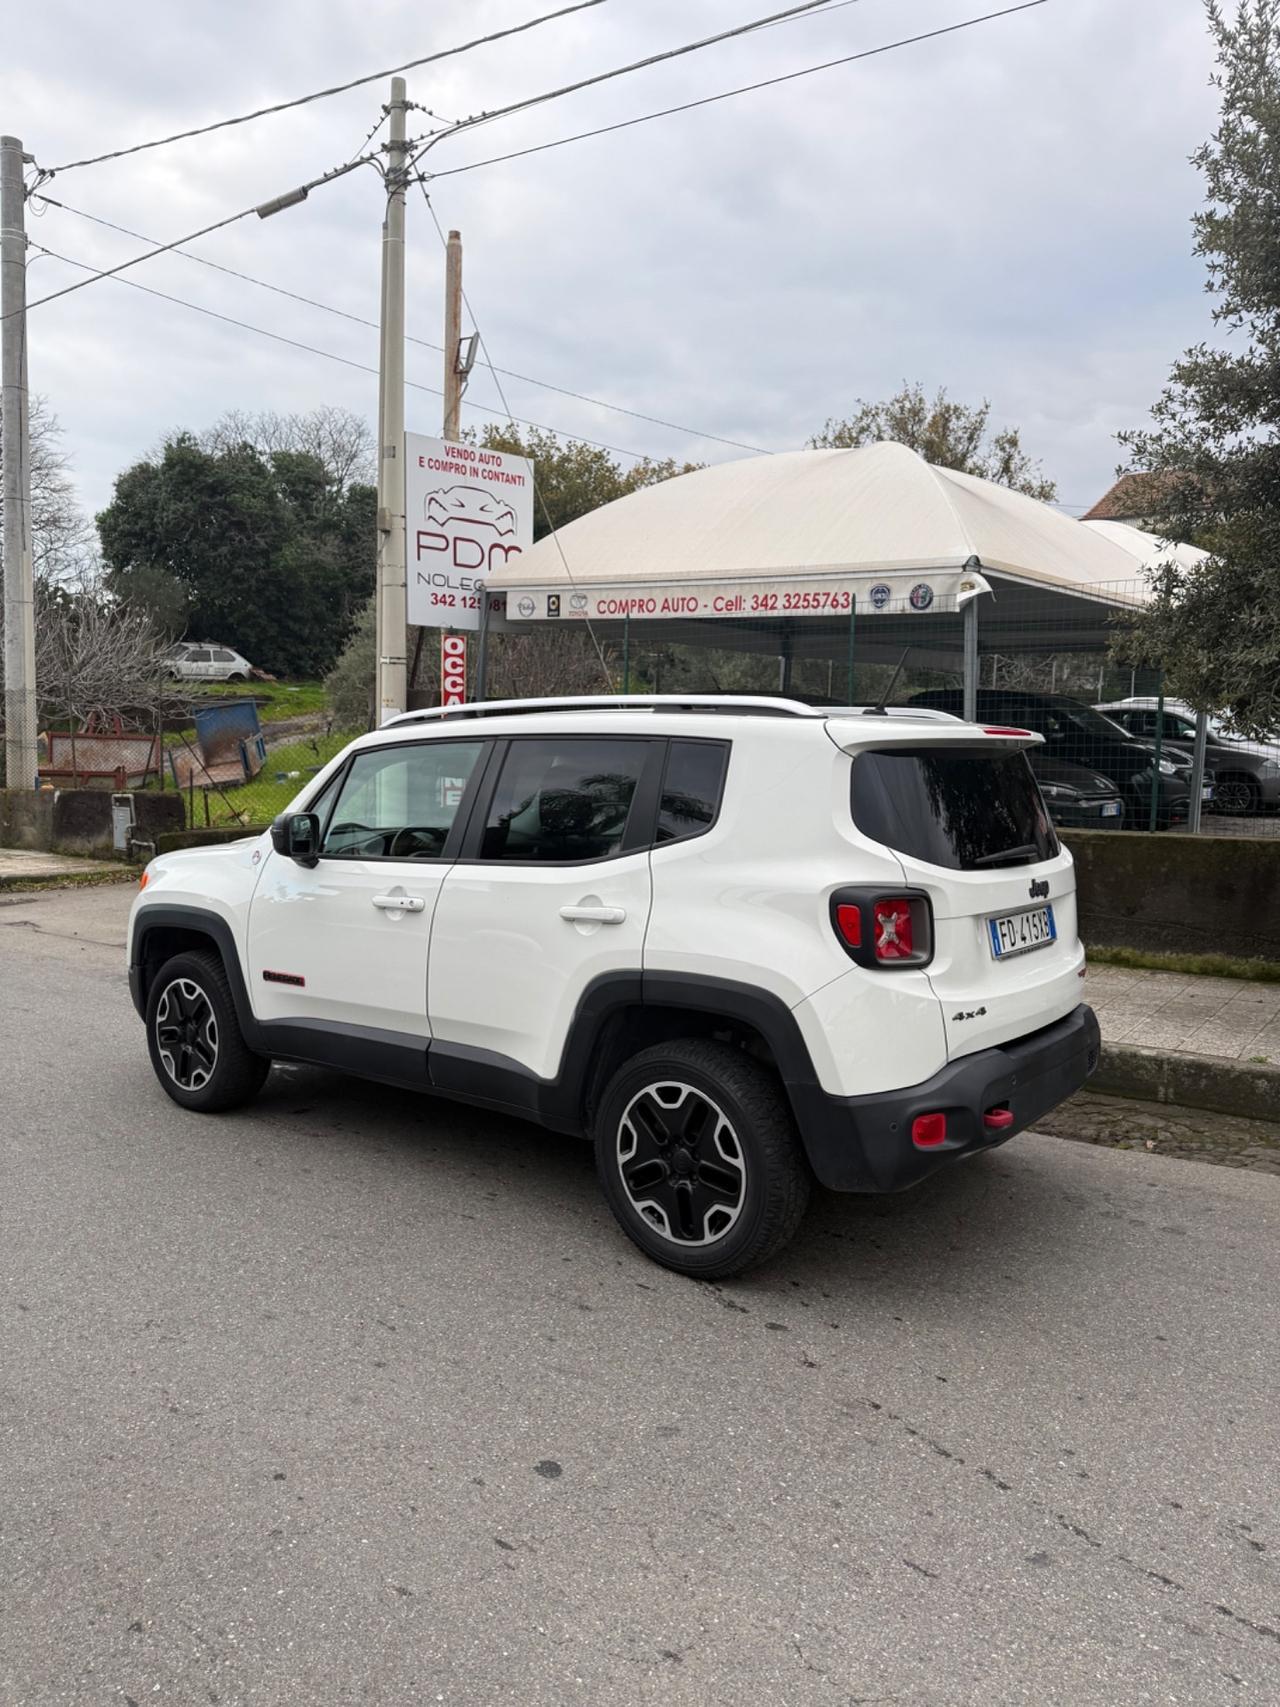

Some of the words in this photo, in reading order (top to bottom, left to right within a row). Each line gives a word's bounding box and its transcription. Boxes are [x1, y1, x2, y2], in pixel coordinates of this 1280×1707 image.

[444, 446, 476, 462] VENDO
[478, 453, 502, 467] AUTO
[418, 456, 425, 468] E
[428, 458, 467, 475] COMPRO
[469, 466, 479, 478] IN
[481, 468, 525, 487] CONTANTI
[431, 592, 456, 607] 342
[597, 599, 656, 614] COMPRO
[660, 597, 698, 613] AUTO
[713, 596, 746, 612] Cell:
[751, 594, 778, 611] 342
[783, 592, 850, 609] 3255763
[1029, 878, 1050, 899] Jeep
